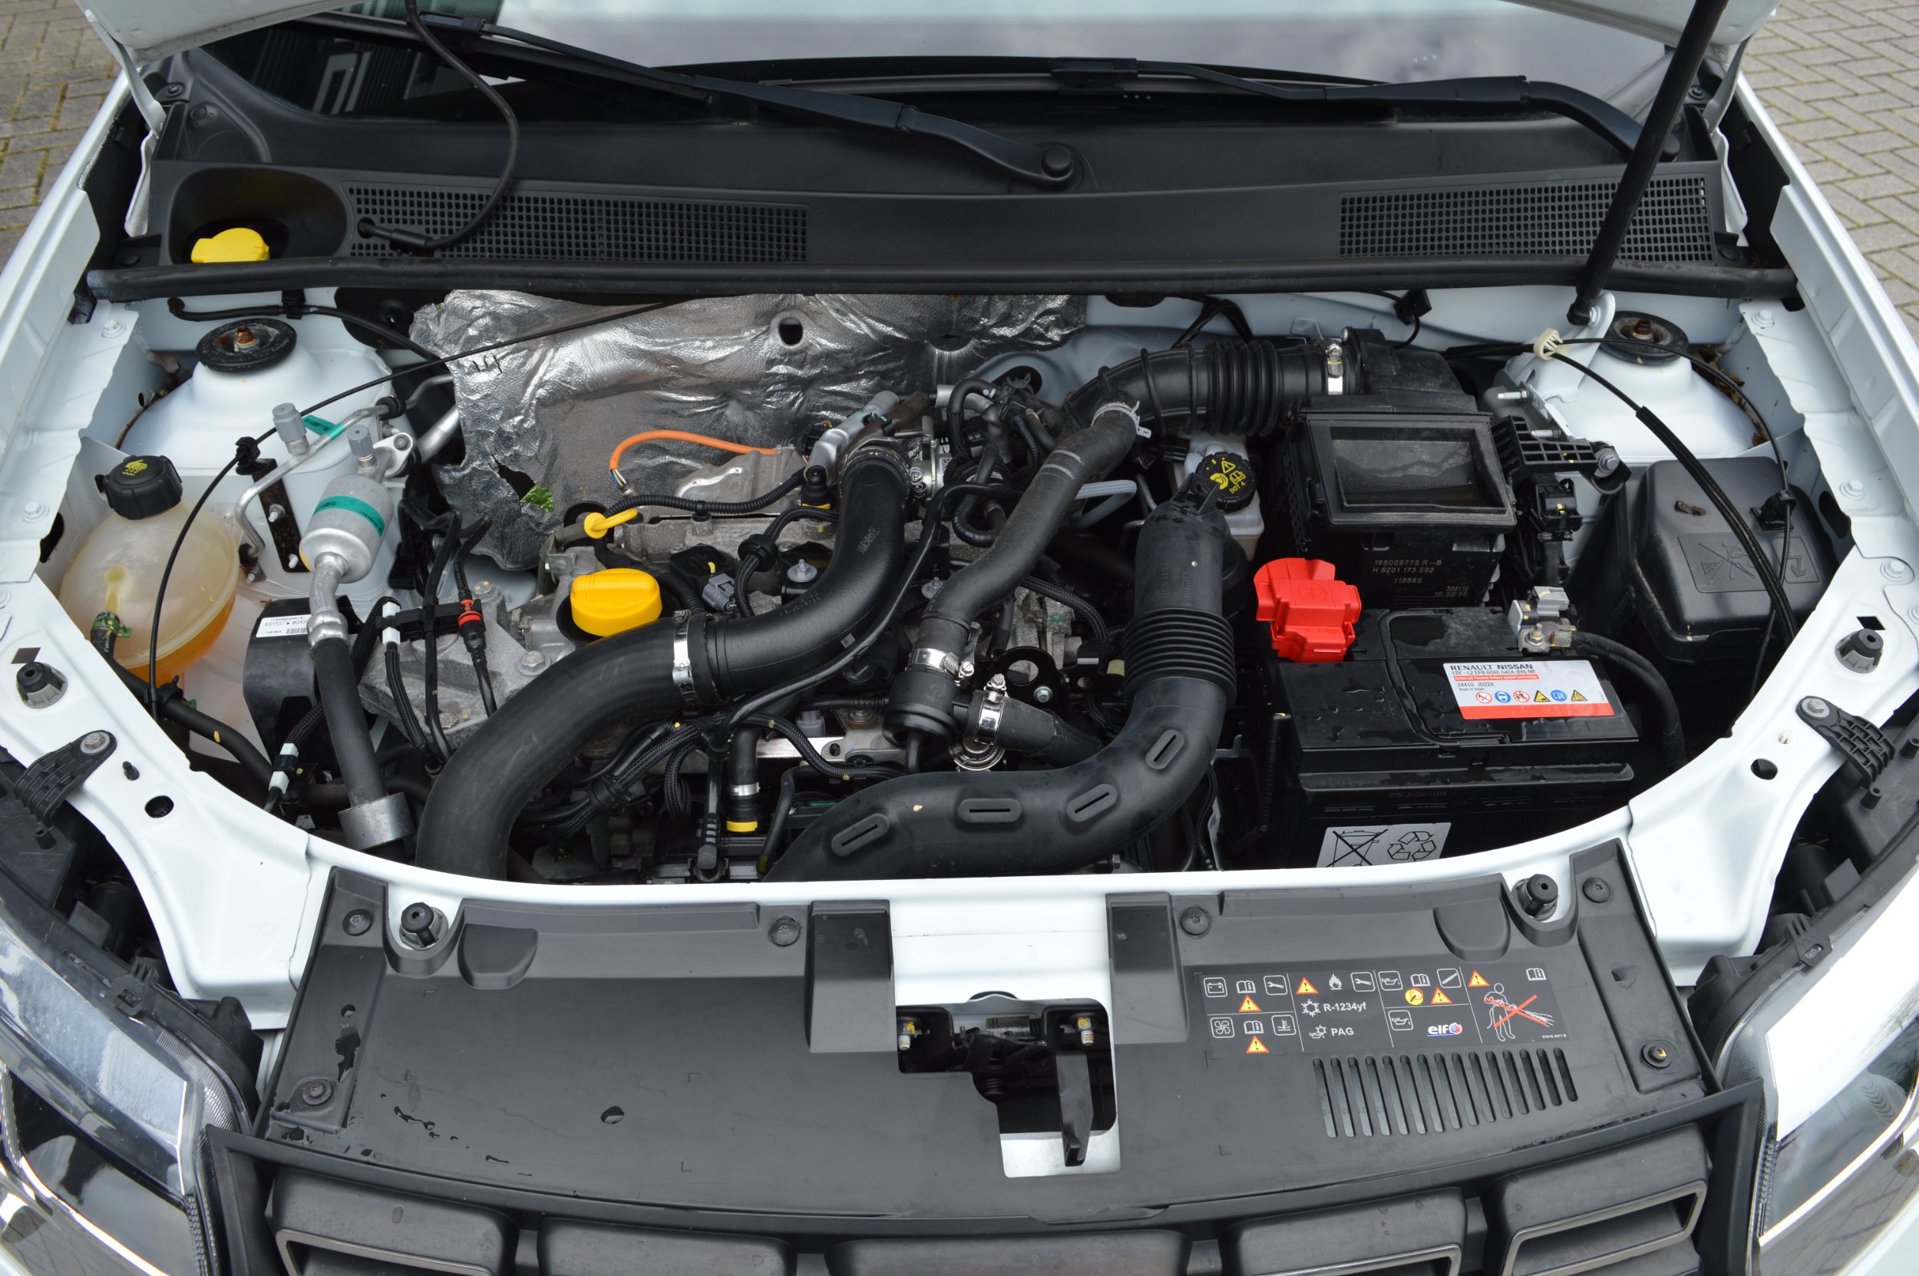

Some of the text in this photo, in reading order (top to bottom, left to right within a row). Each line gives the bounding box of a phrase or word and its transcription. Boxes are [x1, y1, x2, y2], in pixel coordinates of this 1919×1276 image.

[1229, 484, 1241, 494] DOT
[1323, 1001, 1367, 1012] R-1234yf
[1330, 1027, 1355, 1037] PAG
[1427, 1024, 1449, 1035] elf
